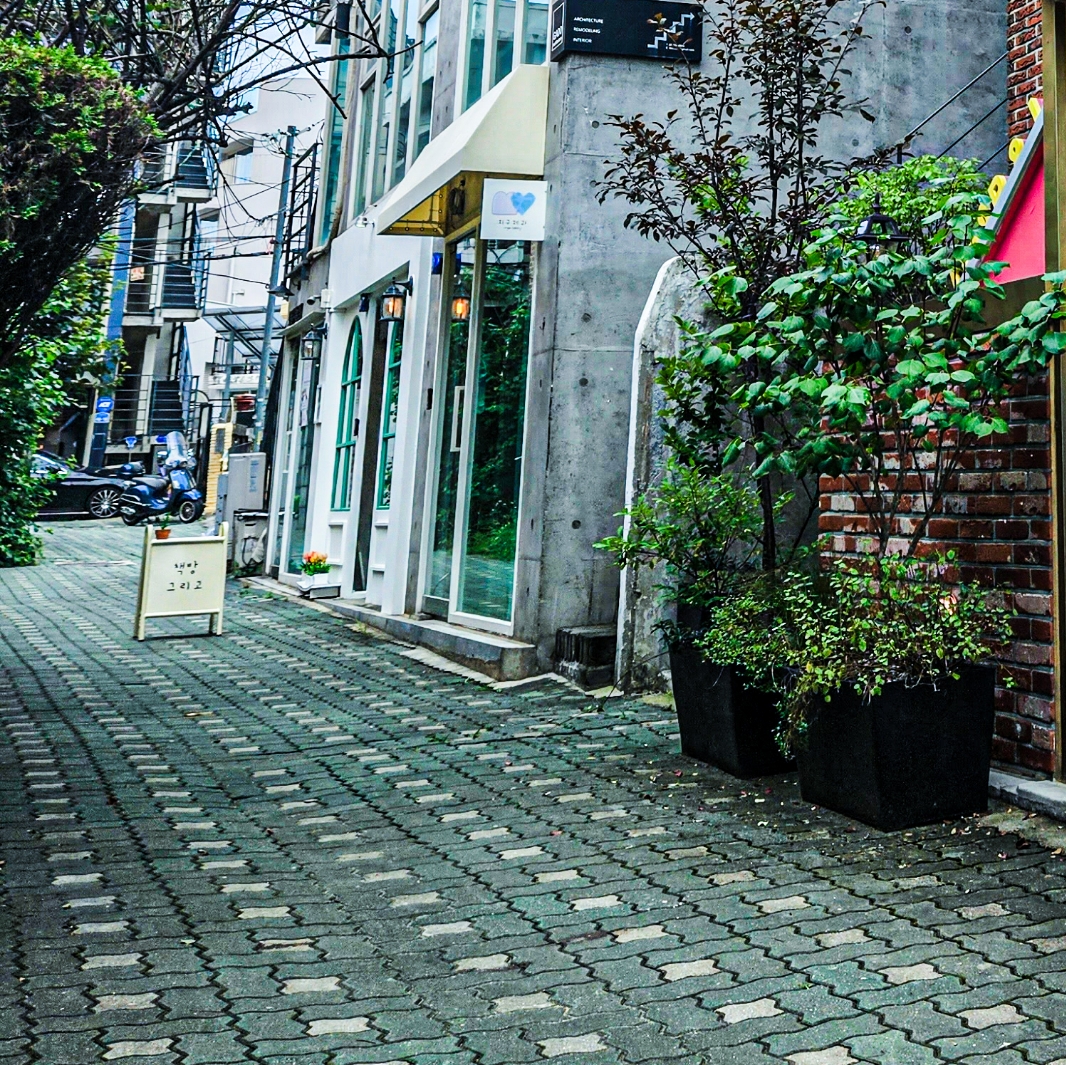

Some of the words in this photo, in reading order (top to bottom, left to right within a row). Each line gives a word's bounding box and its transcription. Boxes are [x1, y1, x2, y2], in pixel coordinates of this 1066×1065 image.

[573, 16, 604, 24] ARCHITECTURE
[174, 560, 198, 575] 책방
[166, 580, 202, 592] 그리고
